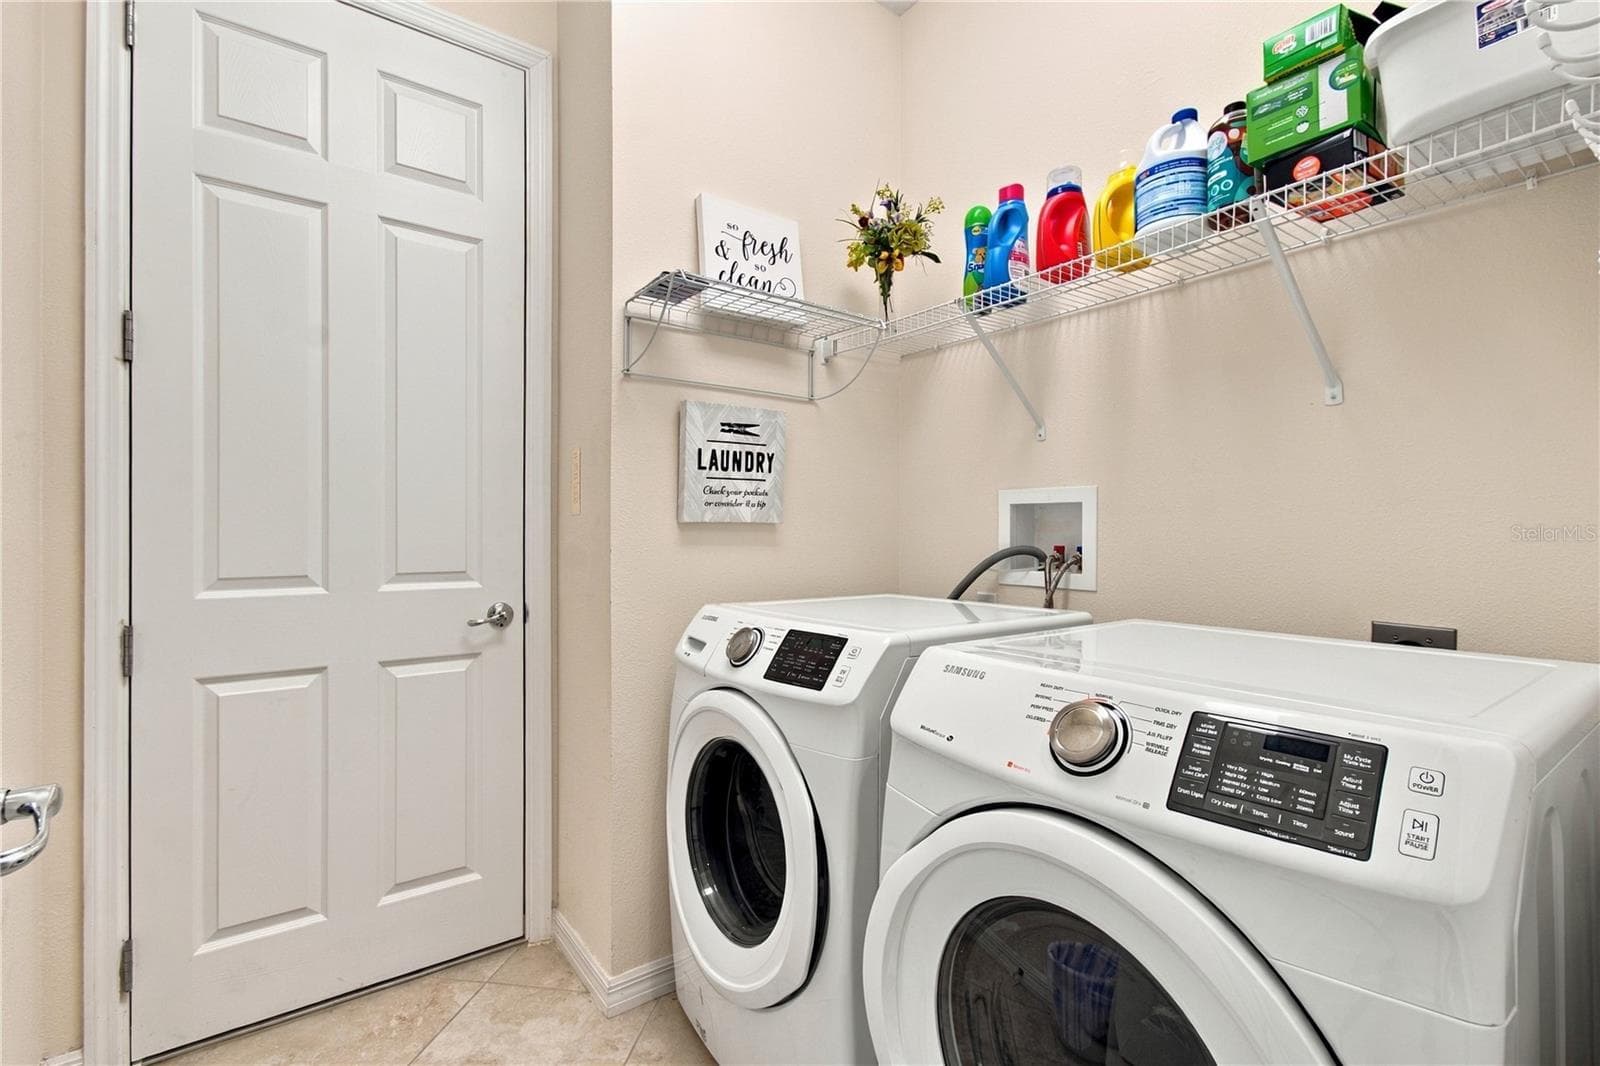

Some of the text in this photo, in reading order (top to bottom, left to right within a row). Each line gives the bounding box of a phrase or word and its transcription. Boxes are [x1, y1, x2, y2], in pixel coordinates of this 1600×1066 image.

[714, 230, 794, 266] & fresh
[718, 260, 772, 293] clean
[697, 447, 775, 474] LAUNDRY
[702, 485, 769, 498] Check your pockets
[714, 498, 743, 508] consider
[943, 664, 986, 680] SAMSUNG
[1154, 706, 1170, 715] QUICK
[1165, 722, 1178, 730] DRY
[1144, 746, 1168, 757] RELEASE
[1145, 741, 1170, 751] WRINKLE
[1343, 753, 1372, 765] My Cycle
[1341, 780, 1356, 790] Time
[1342, 775, 1363, 785] Adjust
[1177, 786, 1191, 795] Drum
[1412, 782, 1440, 793] POWER
[1210, 798, 1238, 810] Dry Level
[1339, 800, 1360, 810] Adjust
[1338, 805, 1354, 815] Time
[1292, 819, 1309, 829] Time
[1334, 828, 1355, 839] Sound
[1406, 832, 1431, 843] START
[1404, 840, 1430, 852] PAUSE
